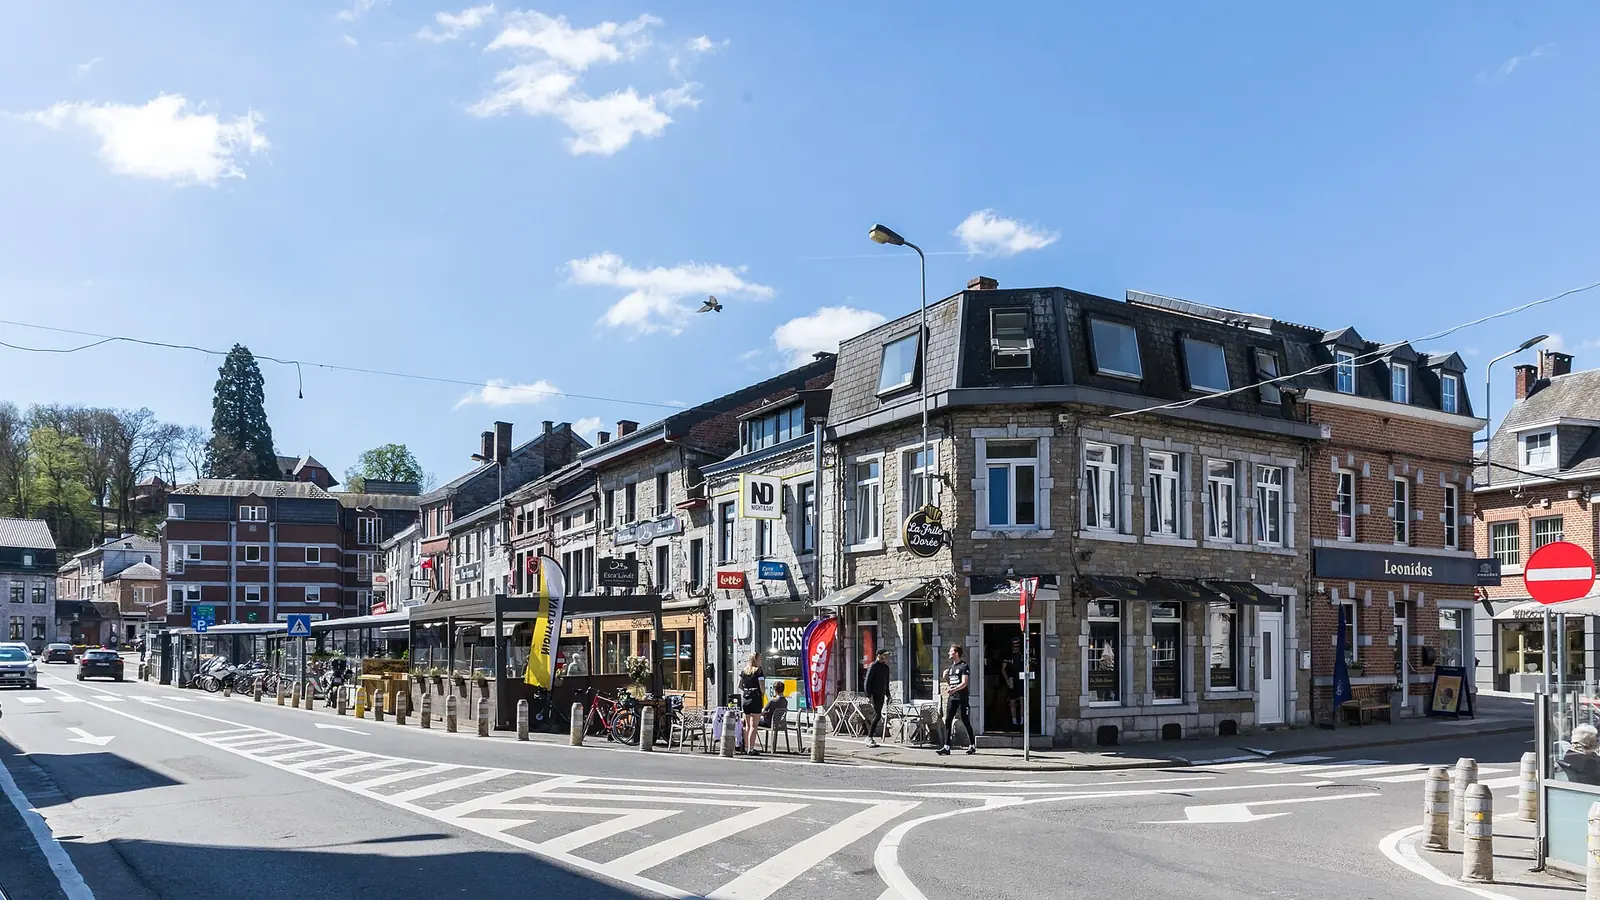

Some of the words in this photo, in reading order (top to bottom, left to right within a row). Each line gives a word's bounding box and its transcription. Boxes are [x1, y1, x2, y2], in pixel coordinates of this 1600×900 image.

[751, 481, 774, 505] ND
[908, 522, 920, 533] La
[920, 523, 943, 536] Frite
[910, 534, 939, 547] Dorée
[1384, 559, 1433, 577] Leonidas
[720, 574, 742, 585] Lotto
[197, 620, 206, 631] P
[771, 626, 807, 651] PRESS
